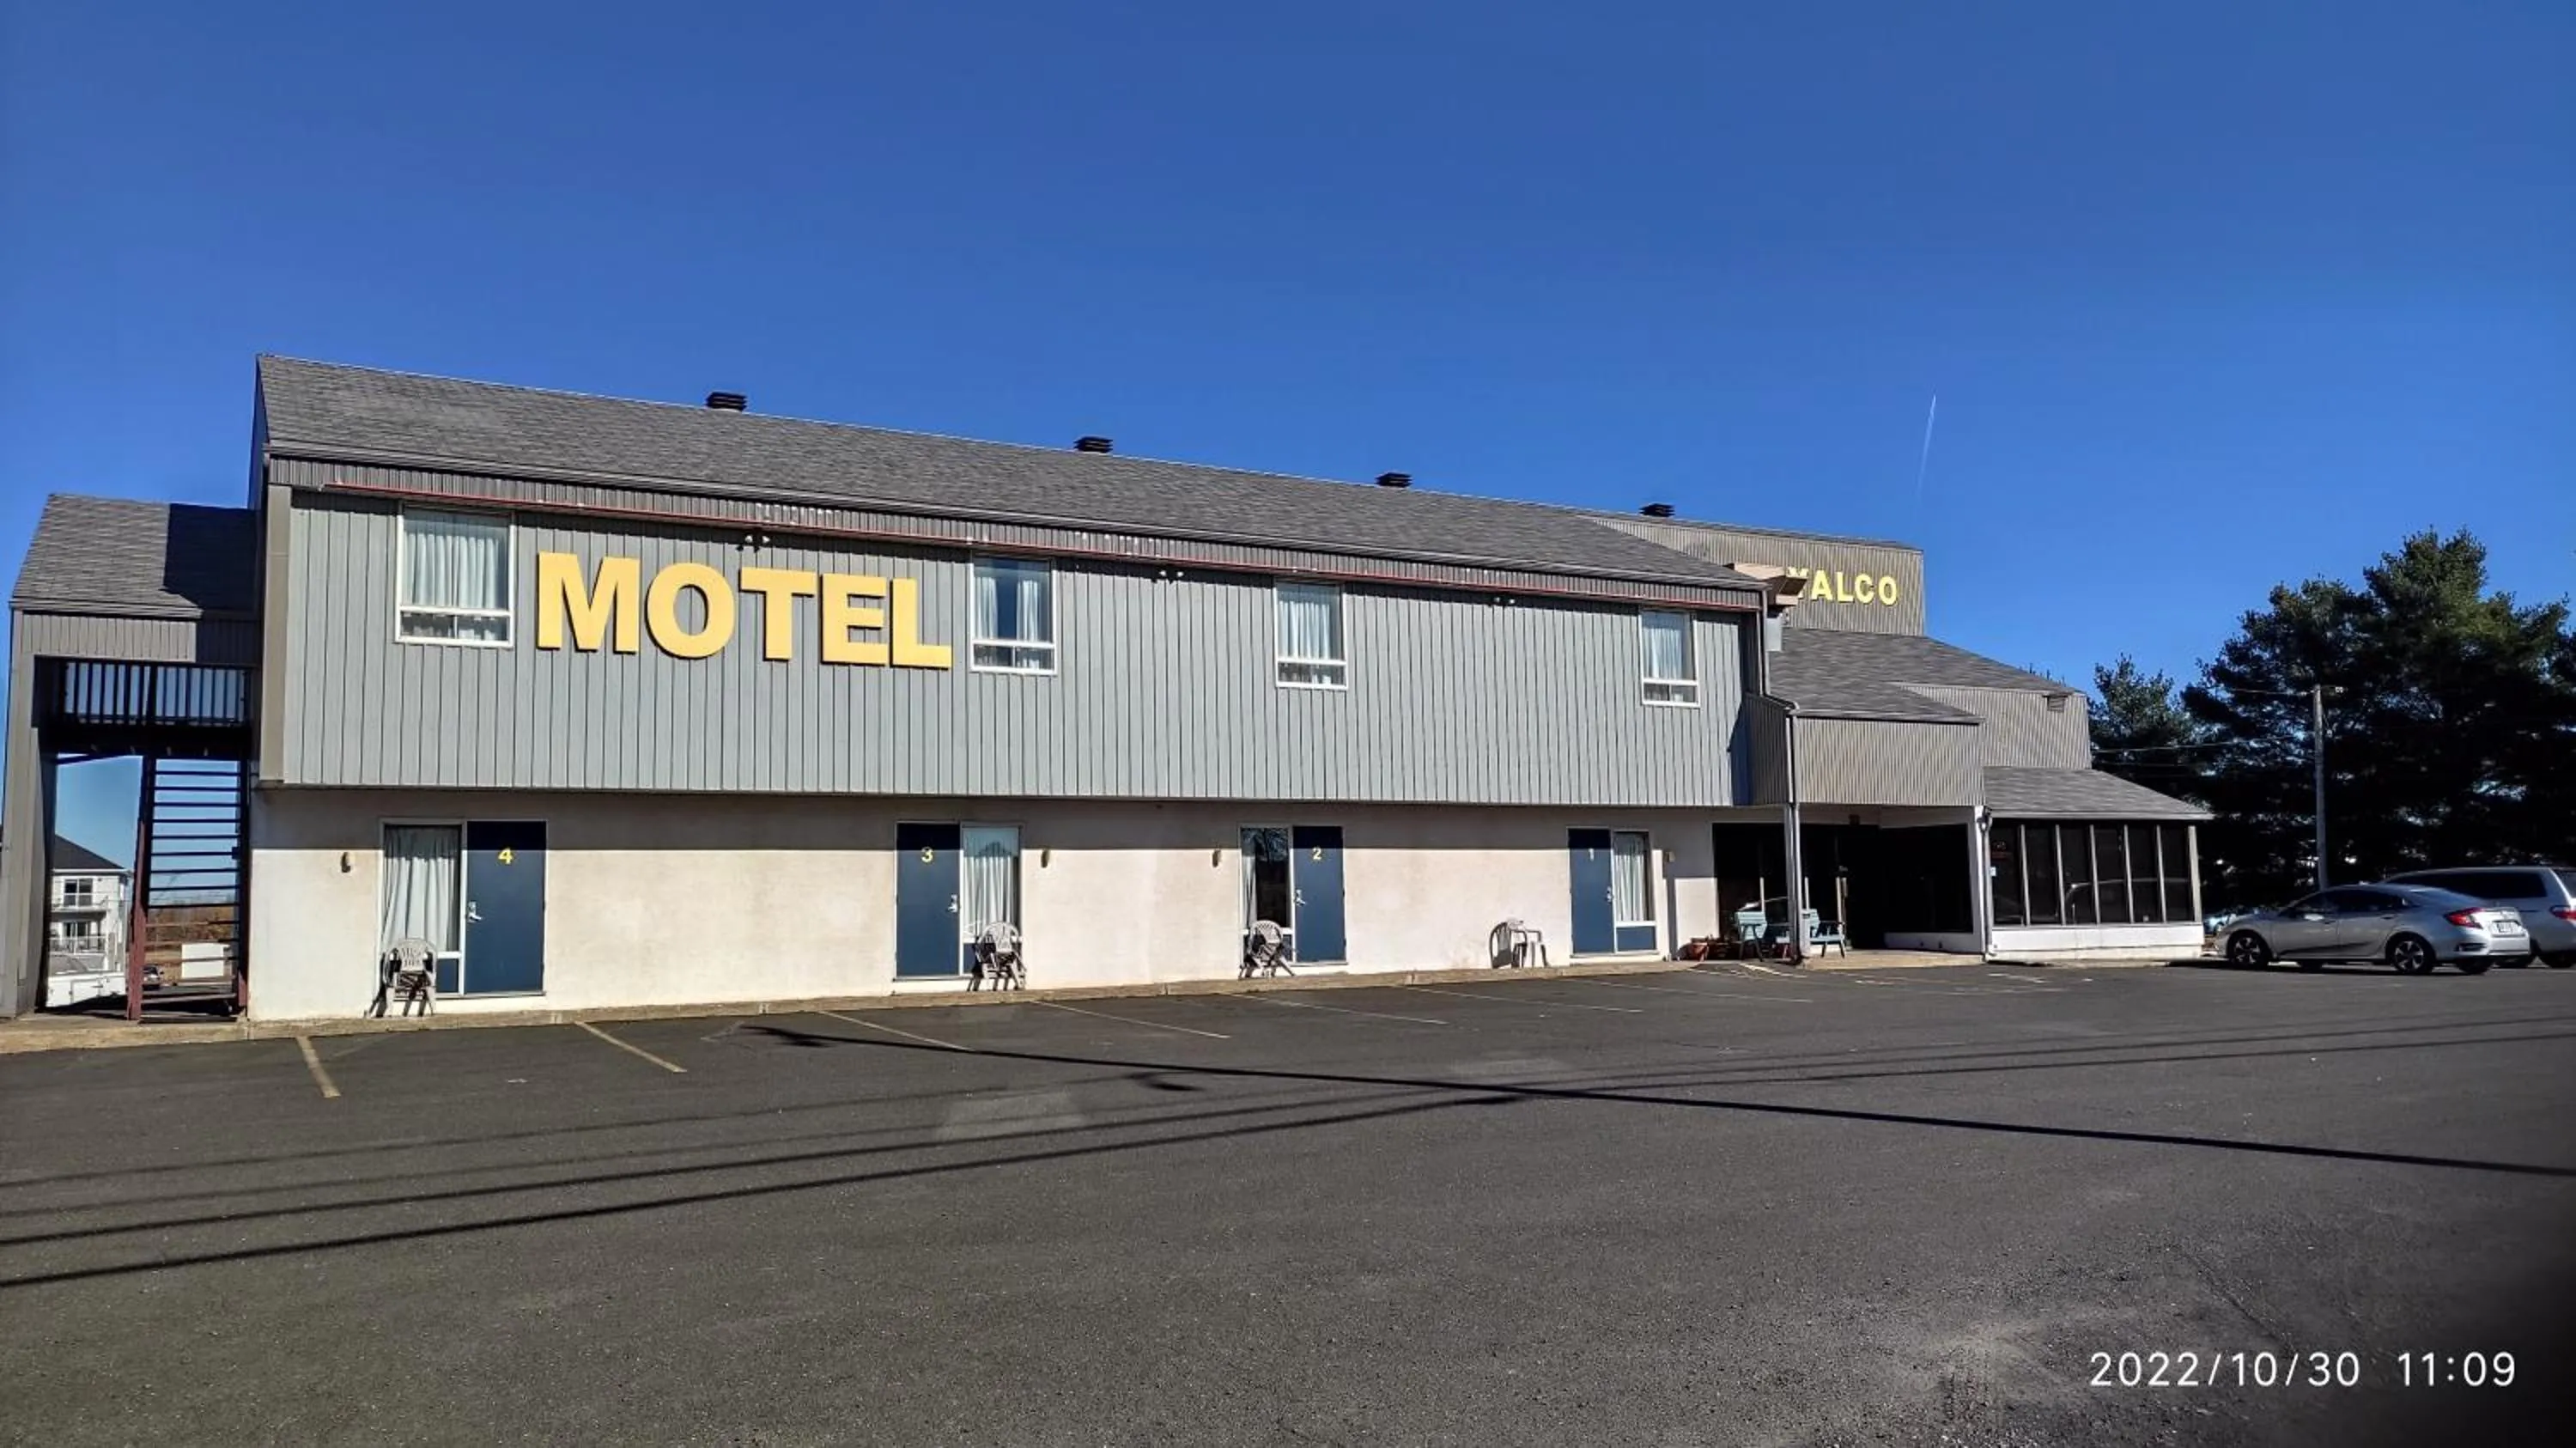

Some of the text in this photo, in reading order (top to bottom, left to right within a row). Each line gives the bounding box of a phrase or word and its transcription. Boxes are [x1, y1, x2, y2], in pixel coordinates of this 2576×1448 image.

[538, 551, 952, 668] MOTEL
[498, 847, 513, 864] 4
[920, 846, 933, 863] 3
[1312, 847, 1321, 860] 2
